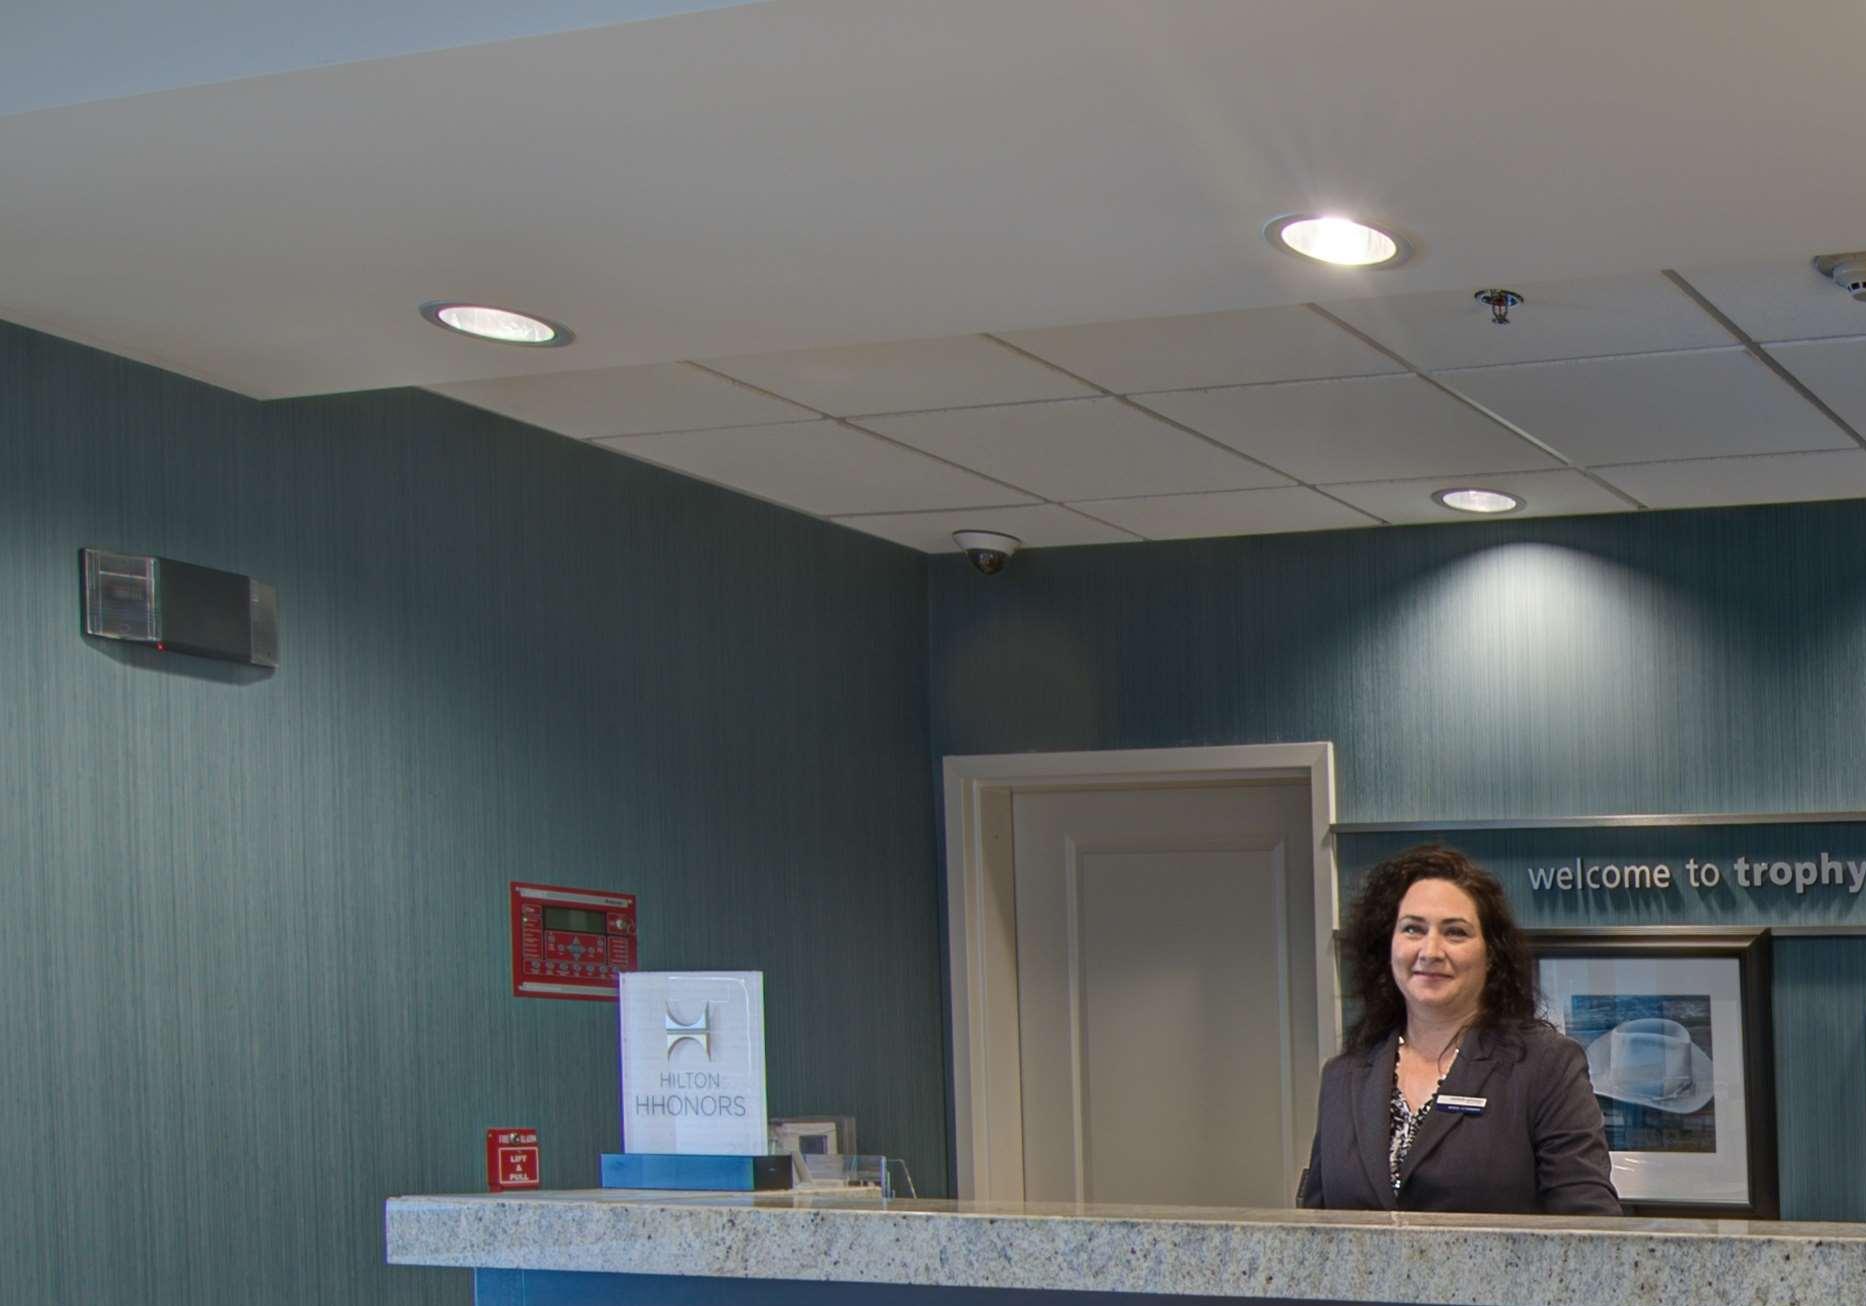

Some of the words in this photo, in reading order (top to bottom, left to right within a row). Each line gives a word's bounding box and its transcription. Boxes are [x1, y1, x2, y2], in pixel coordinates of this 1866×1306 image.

[1528, 857, 1672, 890] welcome
[1686, 858, 1720, 887] to
[660, 1071, 720, 1089] HILTON
[636, 1094, 746, 1117] HHONORS
